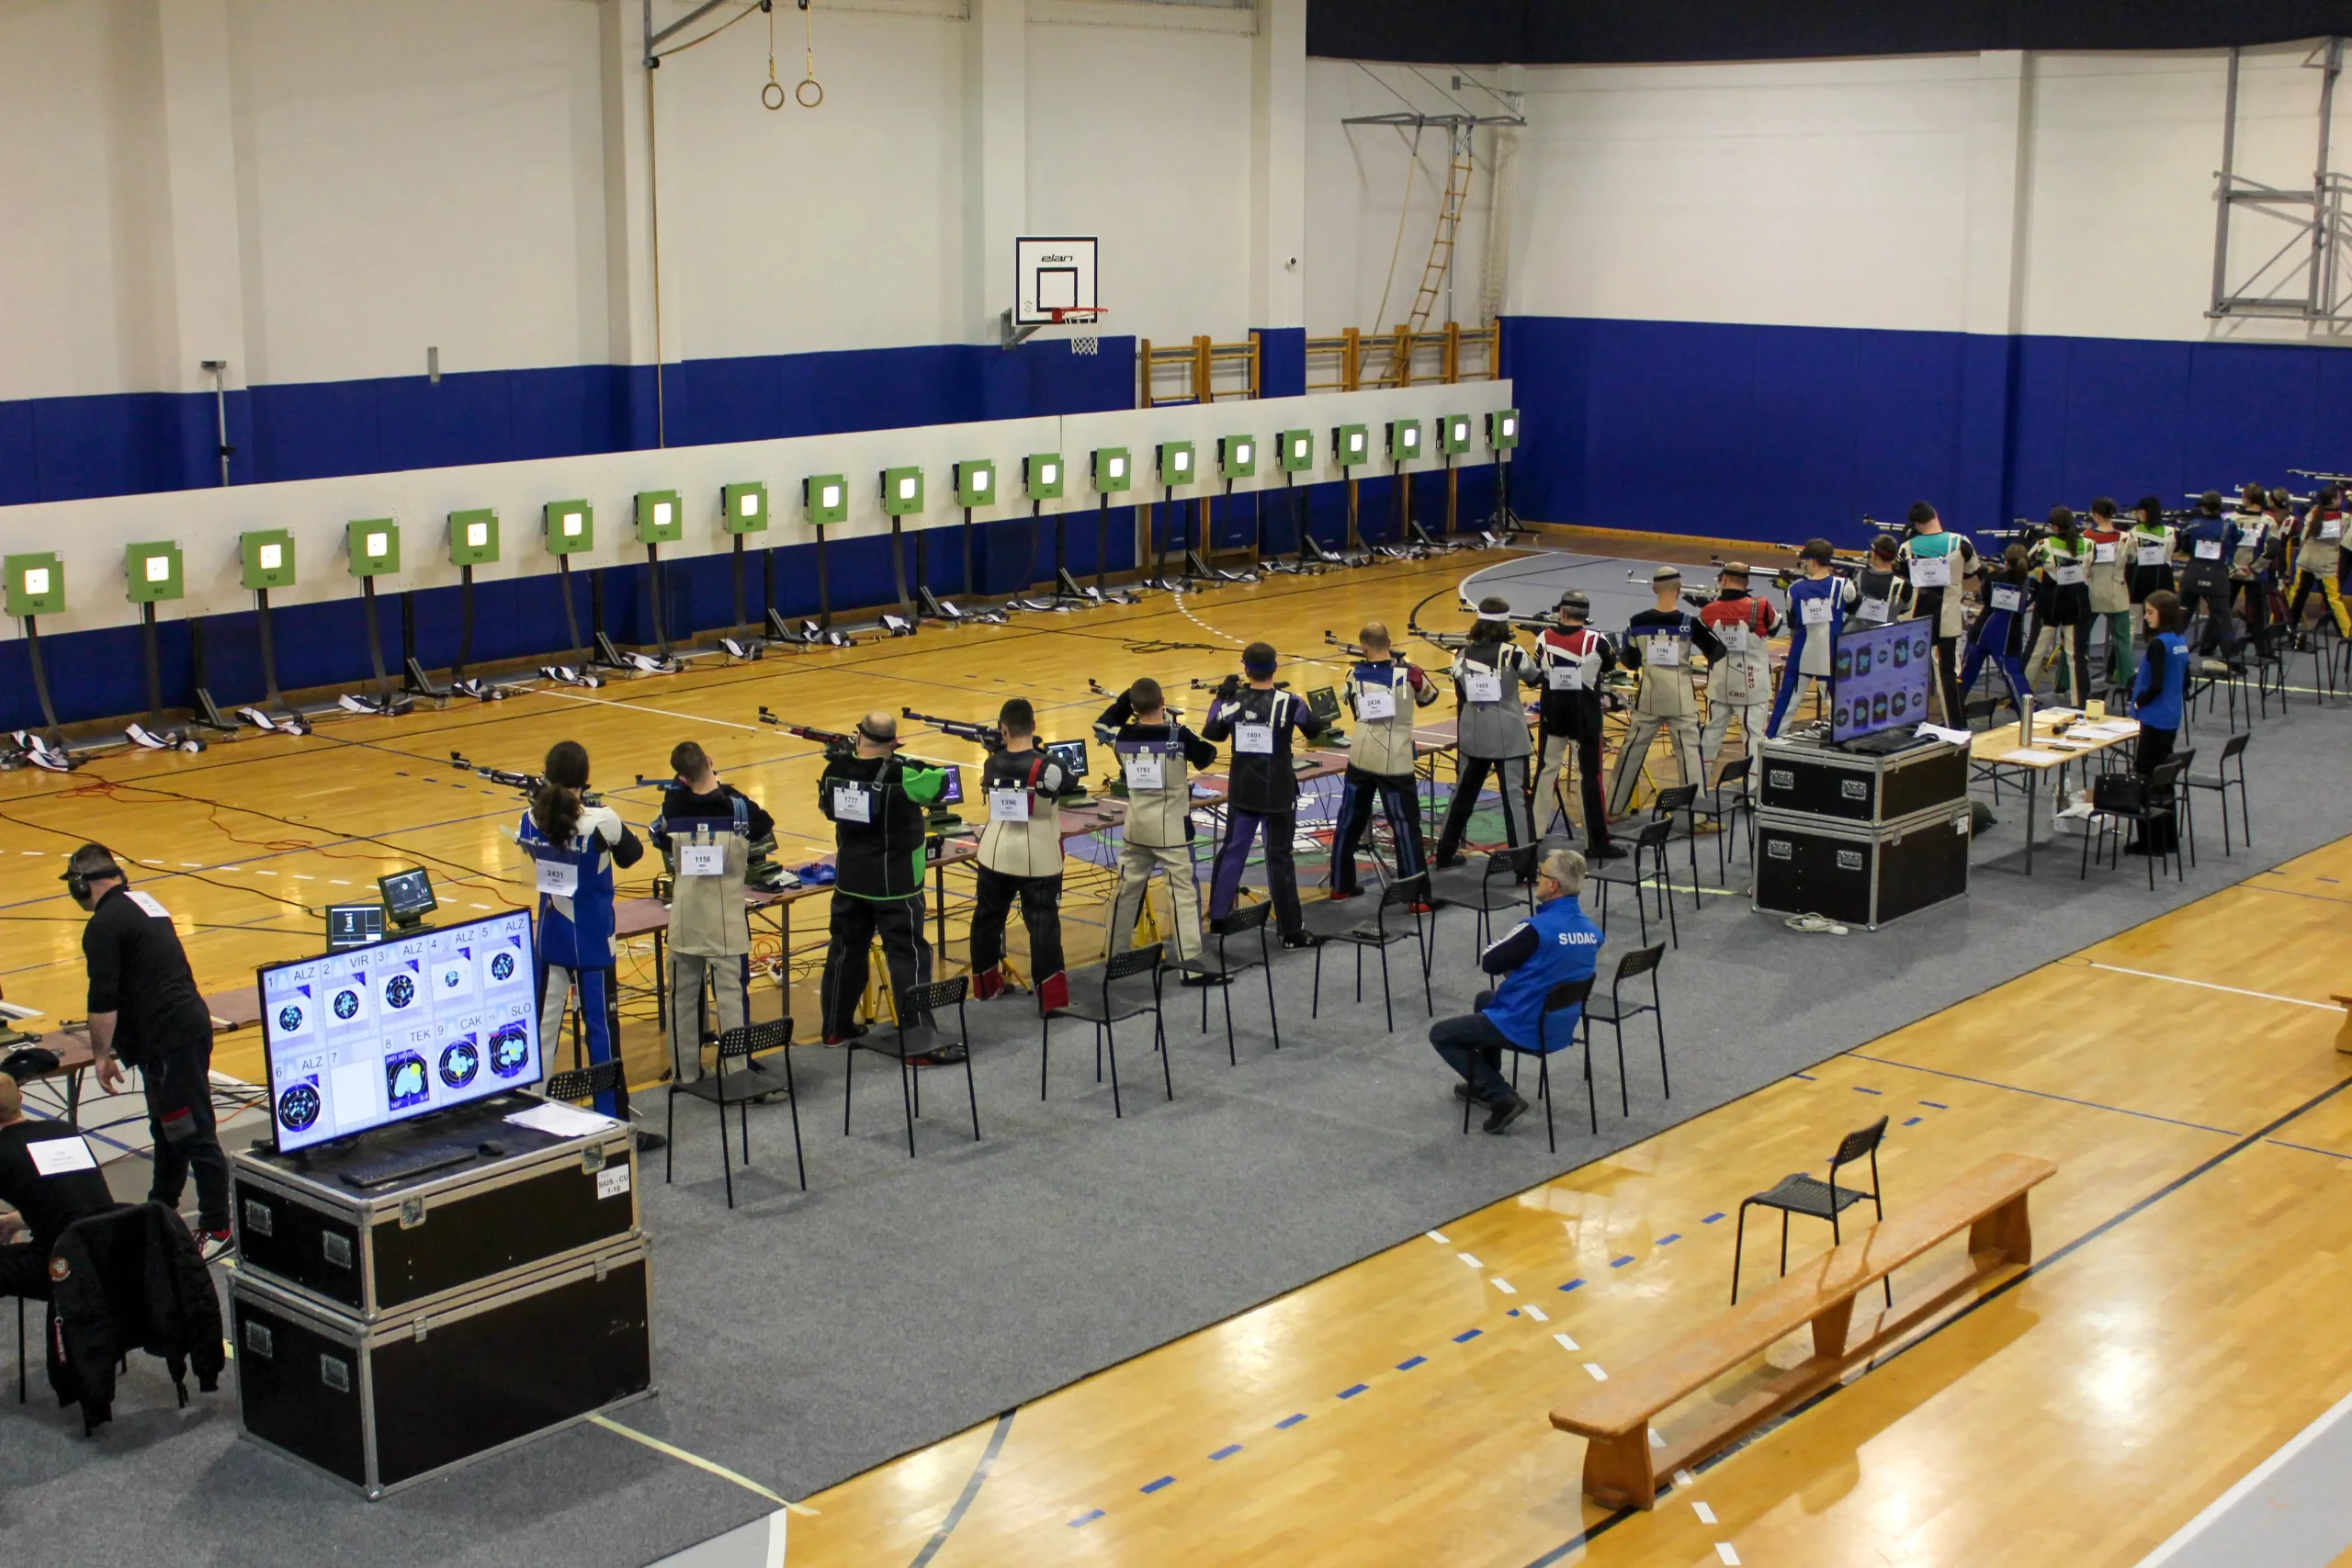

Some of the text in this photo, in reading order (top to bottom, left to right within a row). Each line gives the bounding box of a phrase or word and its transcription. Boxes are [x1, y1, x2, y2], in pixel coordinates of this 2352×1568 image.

[547, 870, 564, 879] 2431
[483, 919, 525, 936] 5 ALZ
[431, 931, 475, 948] 4 ALZ
[1558, 932, 1597, 945] SUDAC
[379, 942, 423, 961] 3 ALZ
[323, 955, 369, 975] 2 VIR
[268, 967, 315, 987] 1 ALZ
[511, 1003, 531, 1016] SLO
[438, 1015, 482, 1035] 9 CAK
[386, 1029, 431, 1048] 8 TEK
[331, 1053, 337, 1062] 7
[276, 1056, 323, 1077] 6 ALZ
[599, 1179, 614, 1188] SIUS
[607, 1186, 620, 1194] 1-10
